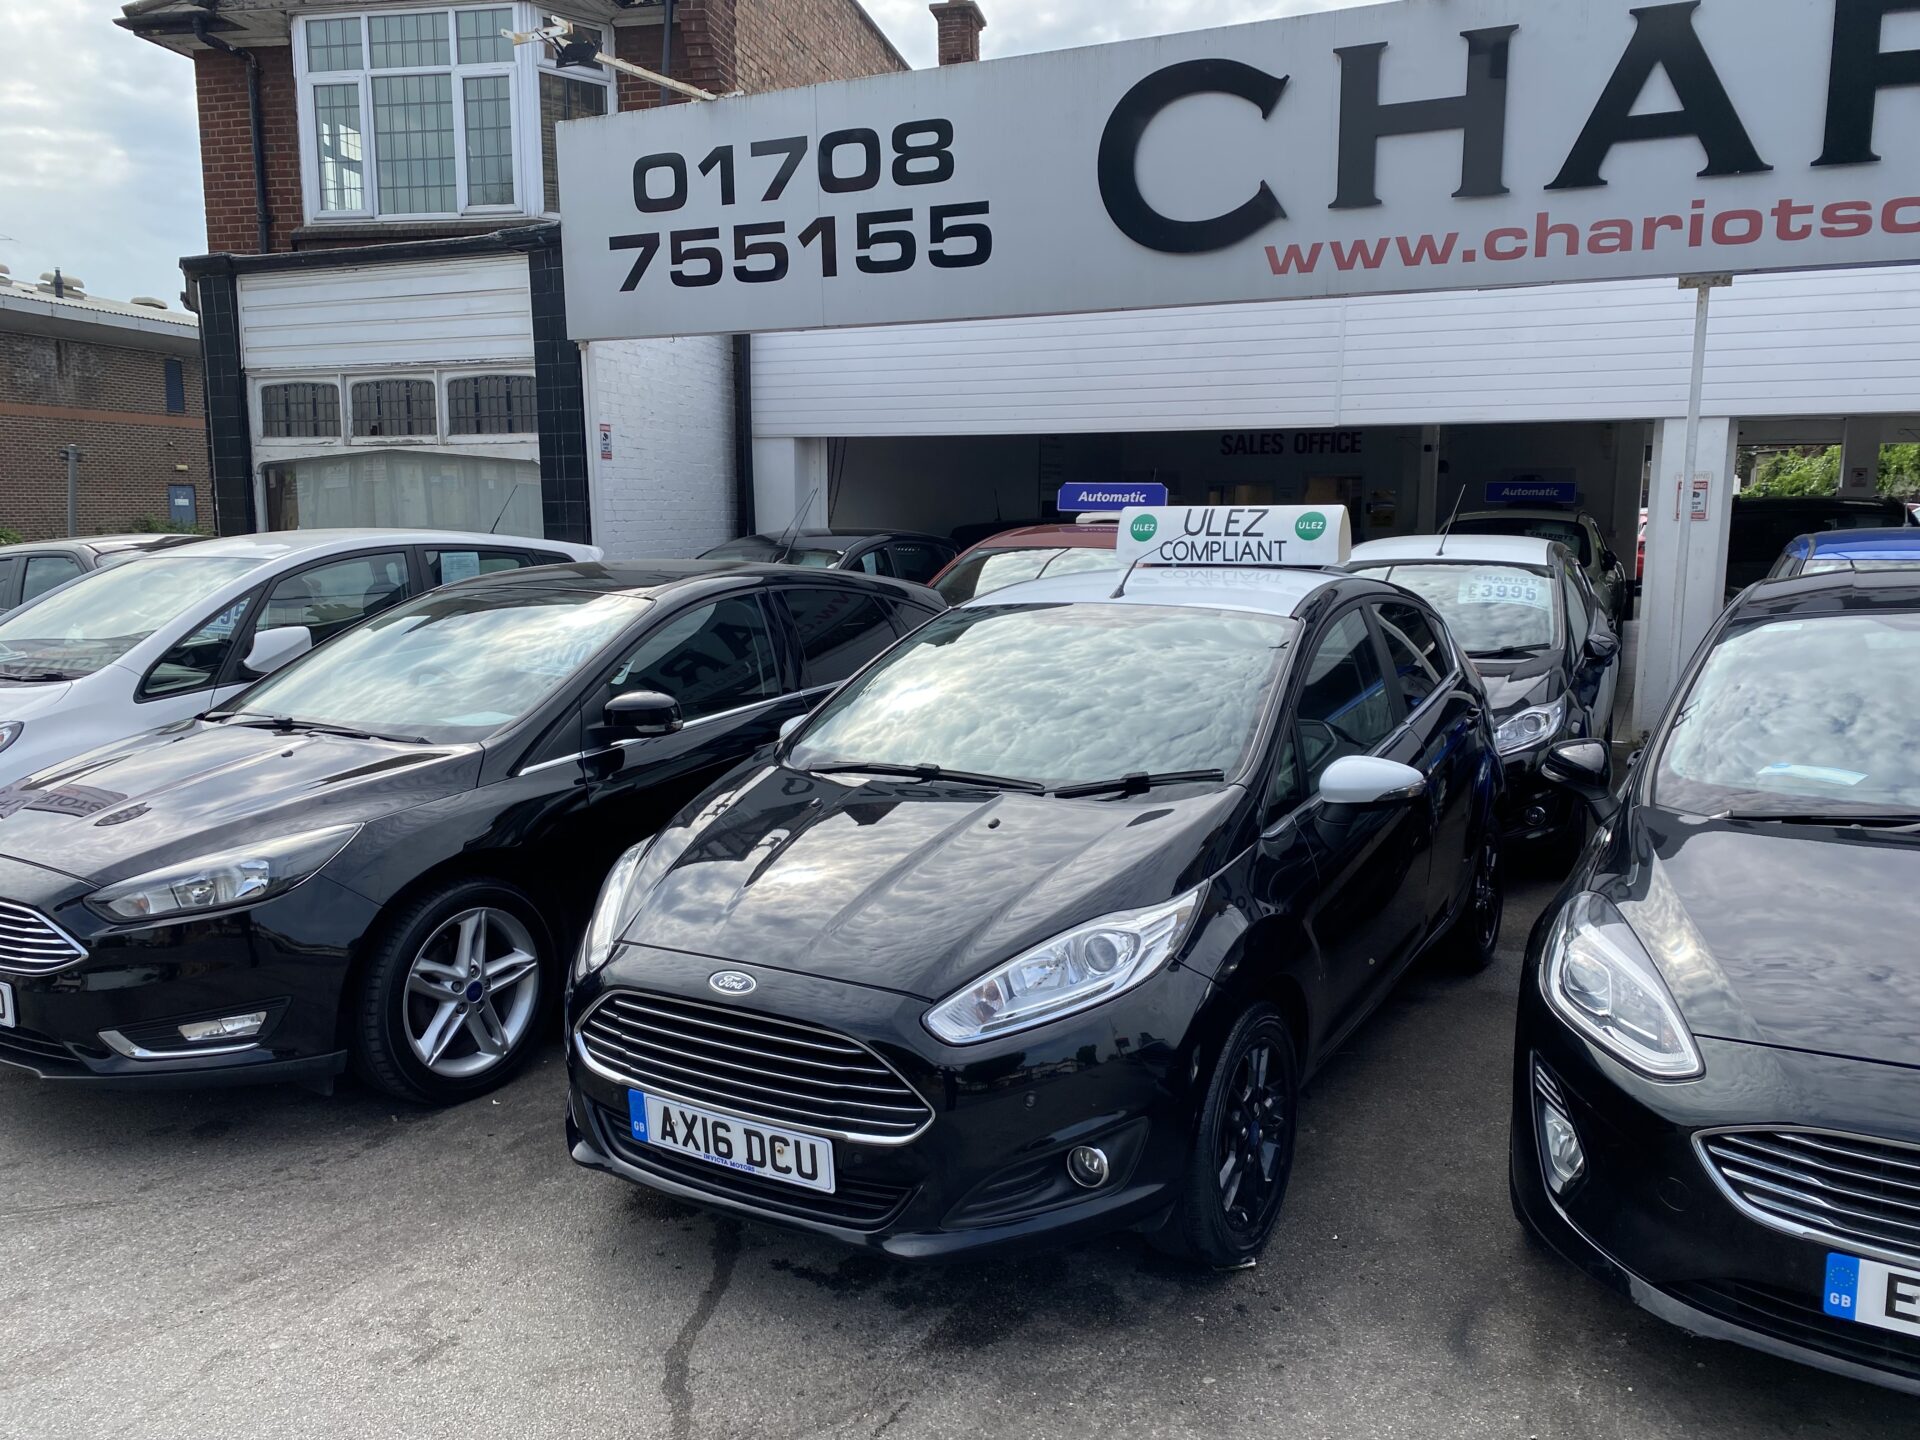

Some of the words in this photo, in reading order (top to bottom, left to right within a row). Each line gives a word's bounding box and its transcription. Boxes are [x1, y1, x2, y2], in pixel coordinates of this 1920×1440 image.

[632, 118, 955, 213] 01708
[608, 200, 993, 292] 755155
[1220, 433, 1285, 456] SALES
[1294, 431, 1362, 454] OFFICE
[1078, 491, 1147, 503] Automatic
[1501, 487, 1560, 497] Automatic
[1133, 523, 1155, 532] ULEZ
[1184, 508, 1269, 537] ULEZ
[1299, 521, 1324, 530] ULEZ
[1160, 540, 1287, 562] COMPLIANT
[718, 974, 747, 989] Ford
[633, 1120, 645, 1133] GB
[660, 1106, 734, 1160] AX16
[744, 1128, 818, 1181] DCU
[703, 1153, 728, 1165] INVICTA
[729, 1160, 755, 1173] MOTORS
[1829, 1292, 1851, 1308] GB
